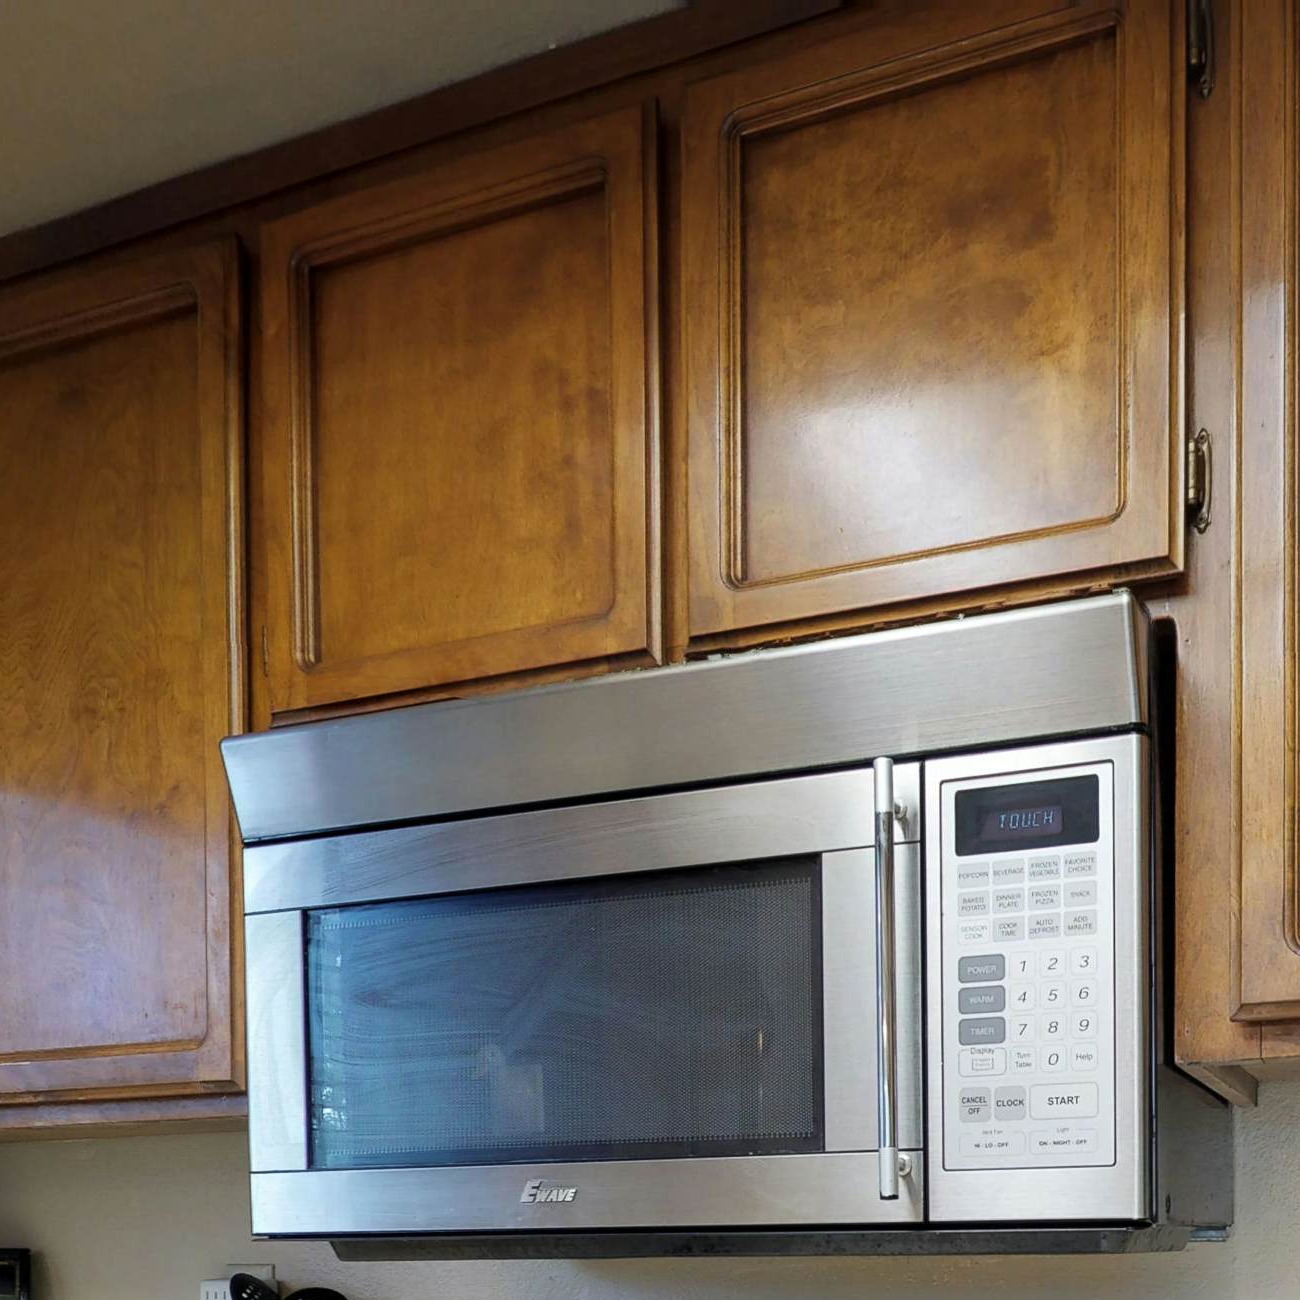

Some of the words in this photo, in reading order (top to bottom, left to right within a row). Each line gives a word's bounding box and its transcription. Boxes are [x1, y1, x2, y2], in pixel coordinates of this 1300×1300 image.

[999, 810, 1054, 829] TOUCH
[1031, 860, 1058, 869] FROZEN
[1065, 857, 1095, 866] FAVORITE
[993, 867, 1025, 876] BEVERAGE
[1068, 864, 1092, 873] CHOICE
[958, 871, 989, 880] POPCORN
[1029, 869, 1059, 878] VEGETABLE
[996, 893, 1021, 901] DINNER
[1031, 889, 1058, 898] FROZEN
[1070, 890, 1091, 898] SNACK
[962, 896, 985, 905] BAKED
[998, 901, 1019, 909] PLATE
[1035, 897, 1055, 905] PIZZA
[961, 904, 986, 912] POTATO
[1035, 918, 1054, 926] AUTO
[1073, 915, 1089, 923] ADD
[960, 924, 988, 933] SENSOR
[999, 921, 1018, 930] COOK
[1029, 925, 1060, 935] DEFROST
[1067, 922, 1092, 931] MINUTE
[963, 932, 984, 941] COOK
[1001, 929, 1017, 937] TIME
[1019, 959, 1027, 973] 1
[1047, 956, 1059, 971] 2
[1079, 954, 1090, 969] 3
[967, 964, 997, 976] POWER
[1017, 990, 1028, 1004] 4
[1047, 988, 1059, 1002] 5
[1078, 986, 1090, 1000] 6
[969, 995, 995, 1005] WARM
[1047, 1020, 1059, 1034] 8
[1078, 1018, 1090, 1032] 9
[970, 1026, 995, 1036] TIMER
[1018, 1023, 1028, 1037] 7
[970, 1047, 995, 1056] Display
[1048, 1053, 1059, 1066] 0
[1075, 1053, 1093, 1061] Help
[961, 1096, 988, 1105] CANCEL
[996, 1098, 1025, 1108] CLOCK
[1047, 1095, 1081, 1106] START
[967, 1107, 981, 1115] OFF
